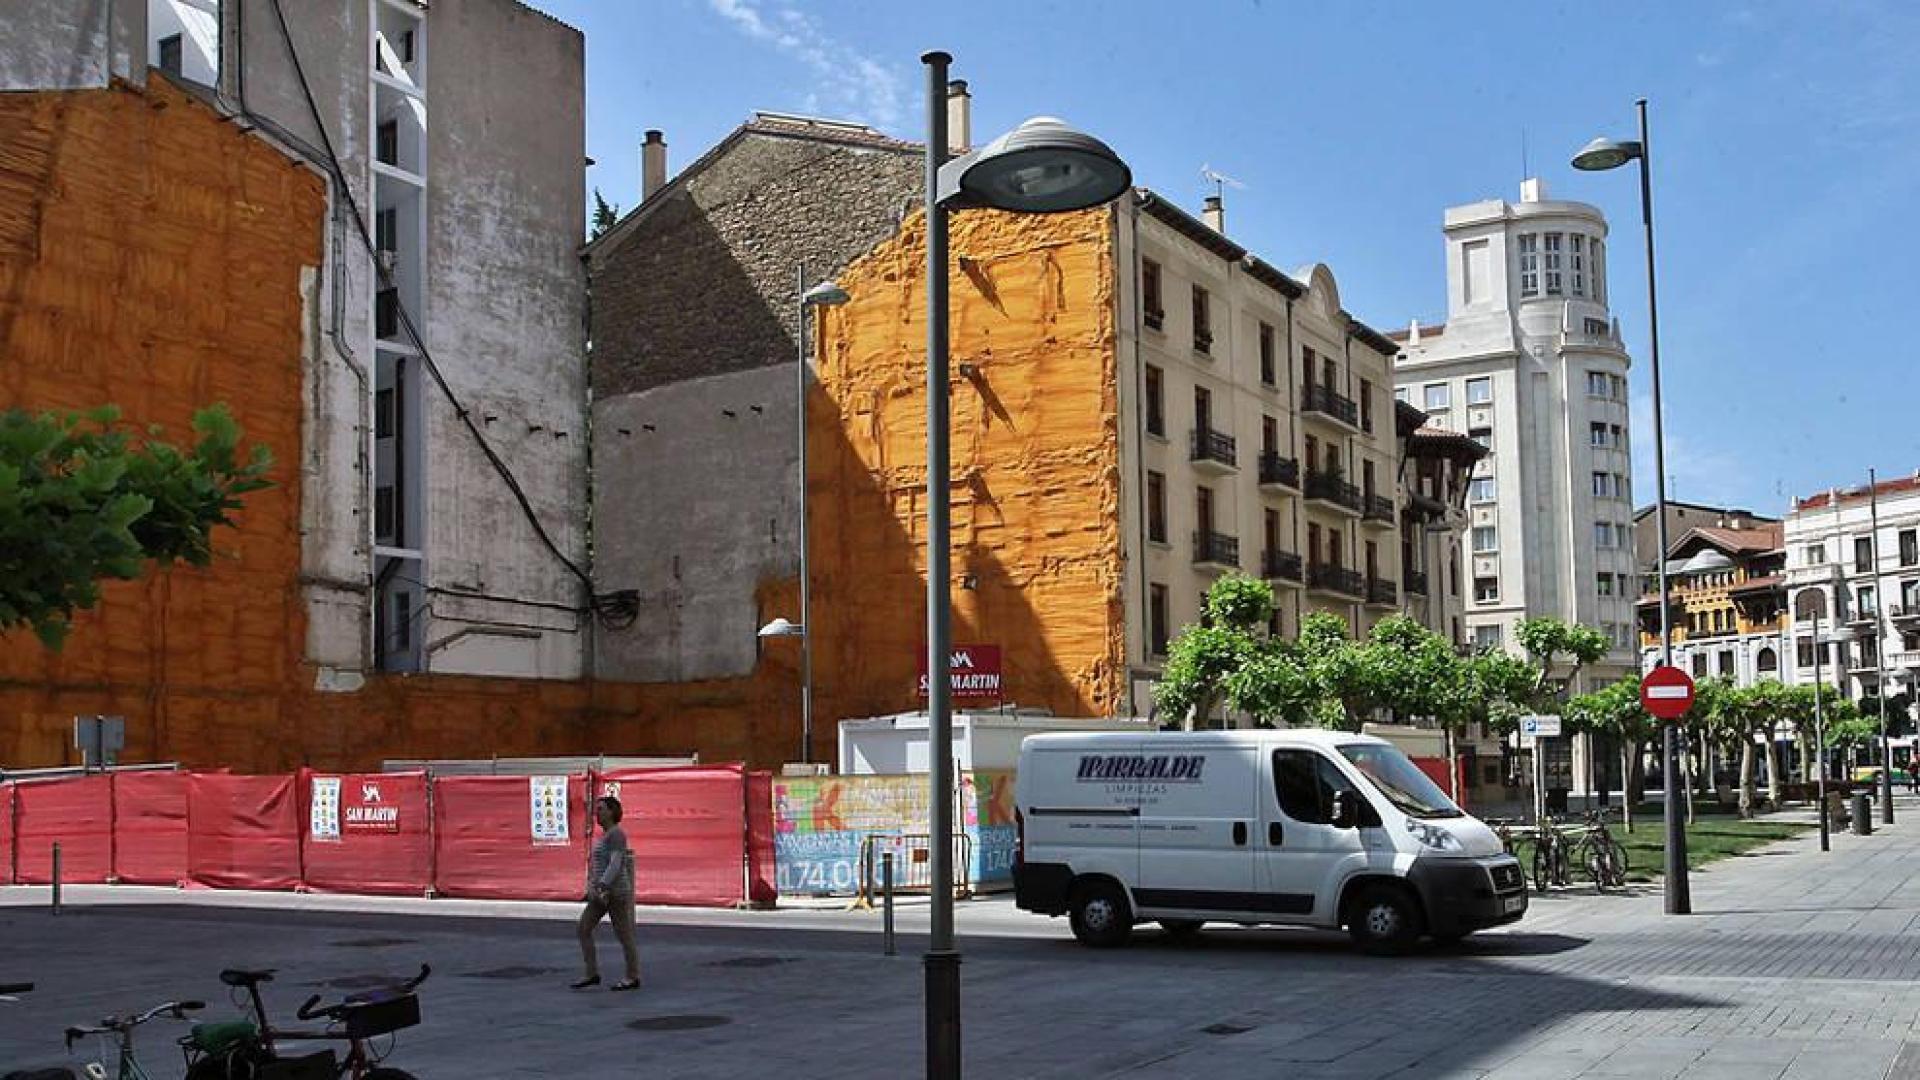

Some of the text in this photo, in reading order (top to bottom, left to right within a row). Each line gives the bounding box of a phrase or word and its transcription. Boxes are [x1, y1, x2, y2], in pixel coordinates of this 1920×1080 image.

[950, 673, 1000, 690] MARTIN
[1105, 784, 1168, 794] LIMPIEZAS
[346, 807, 399, 821] SAN MARTIN
